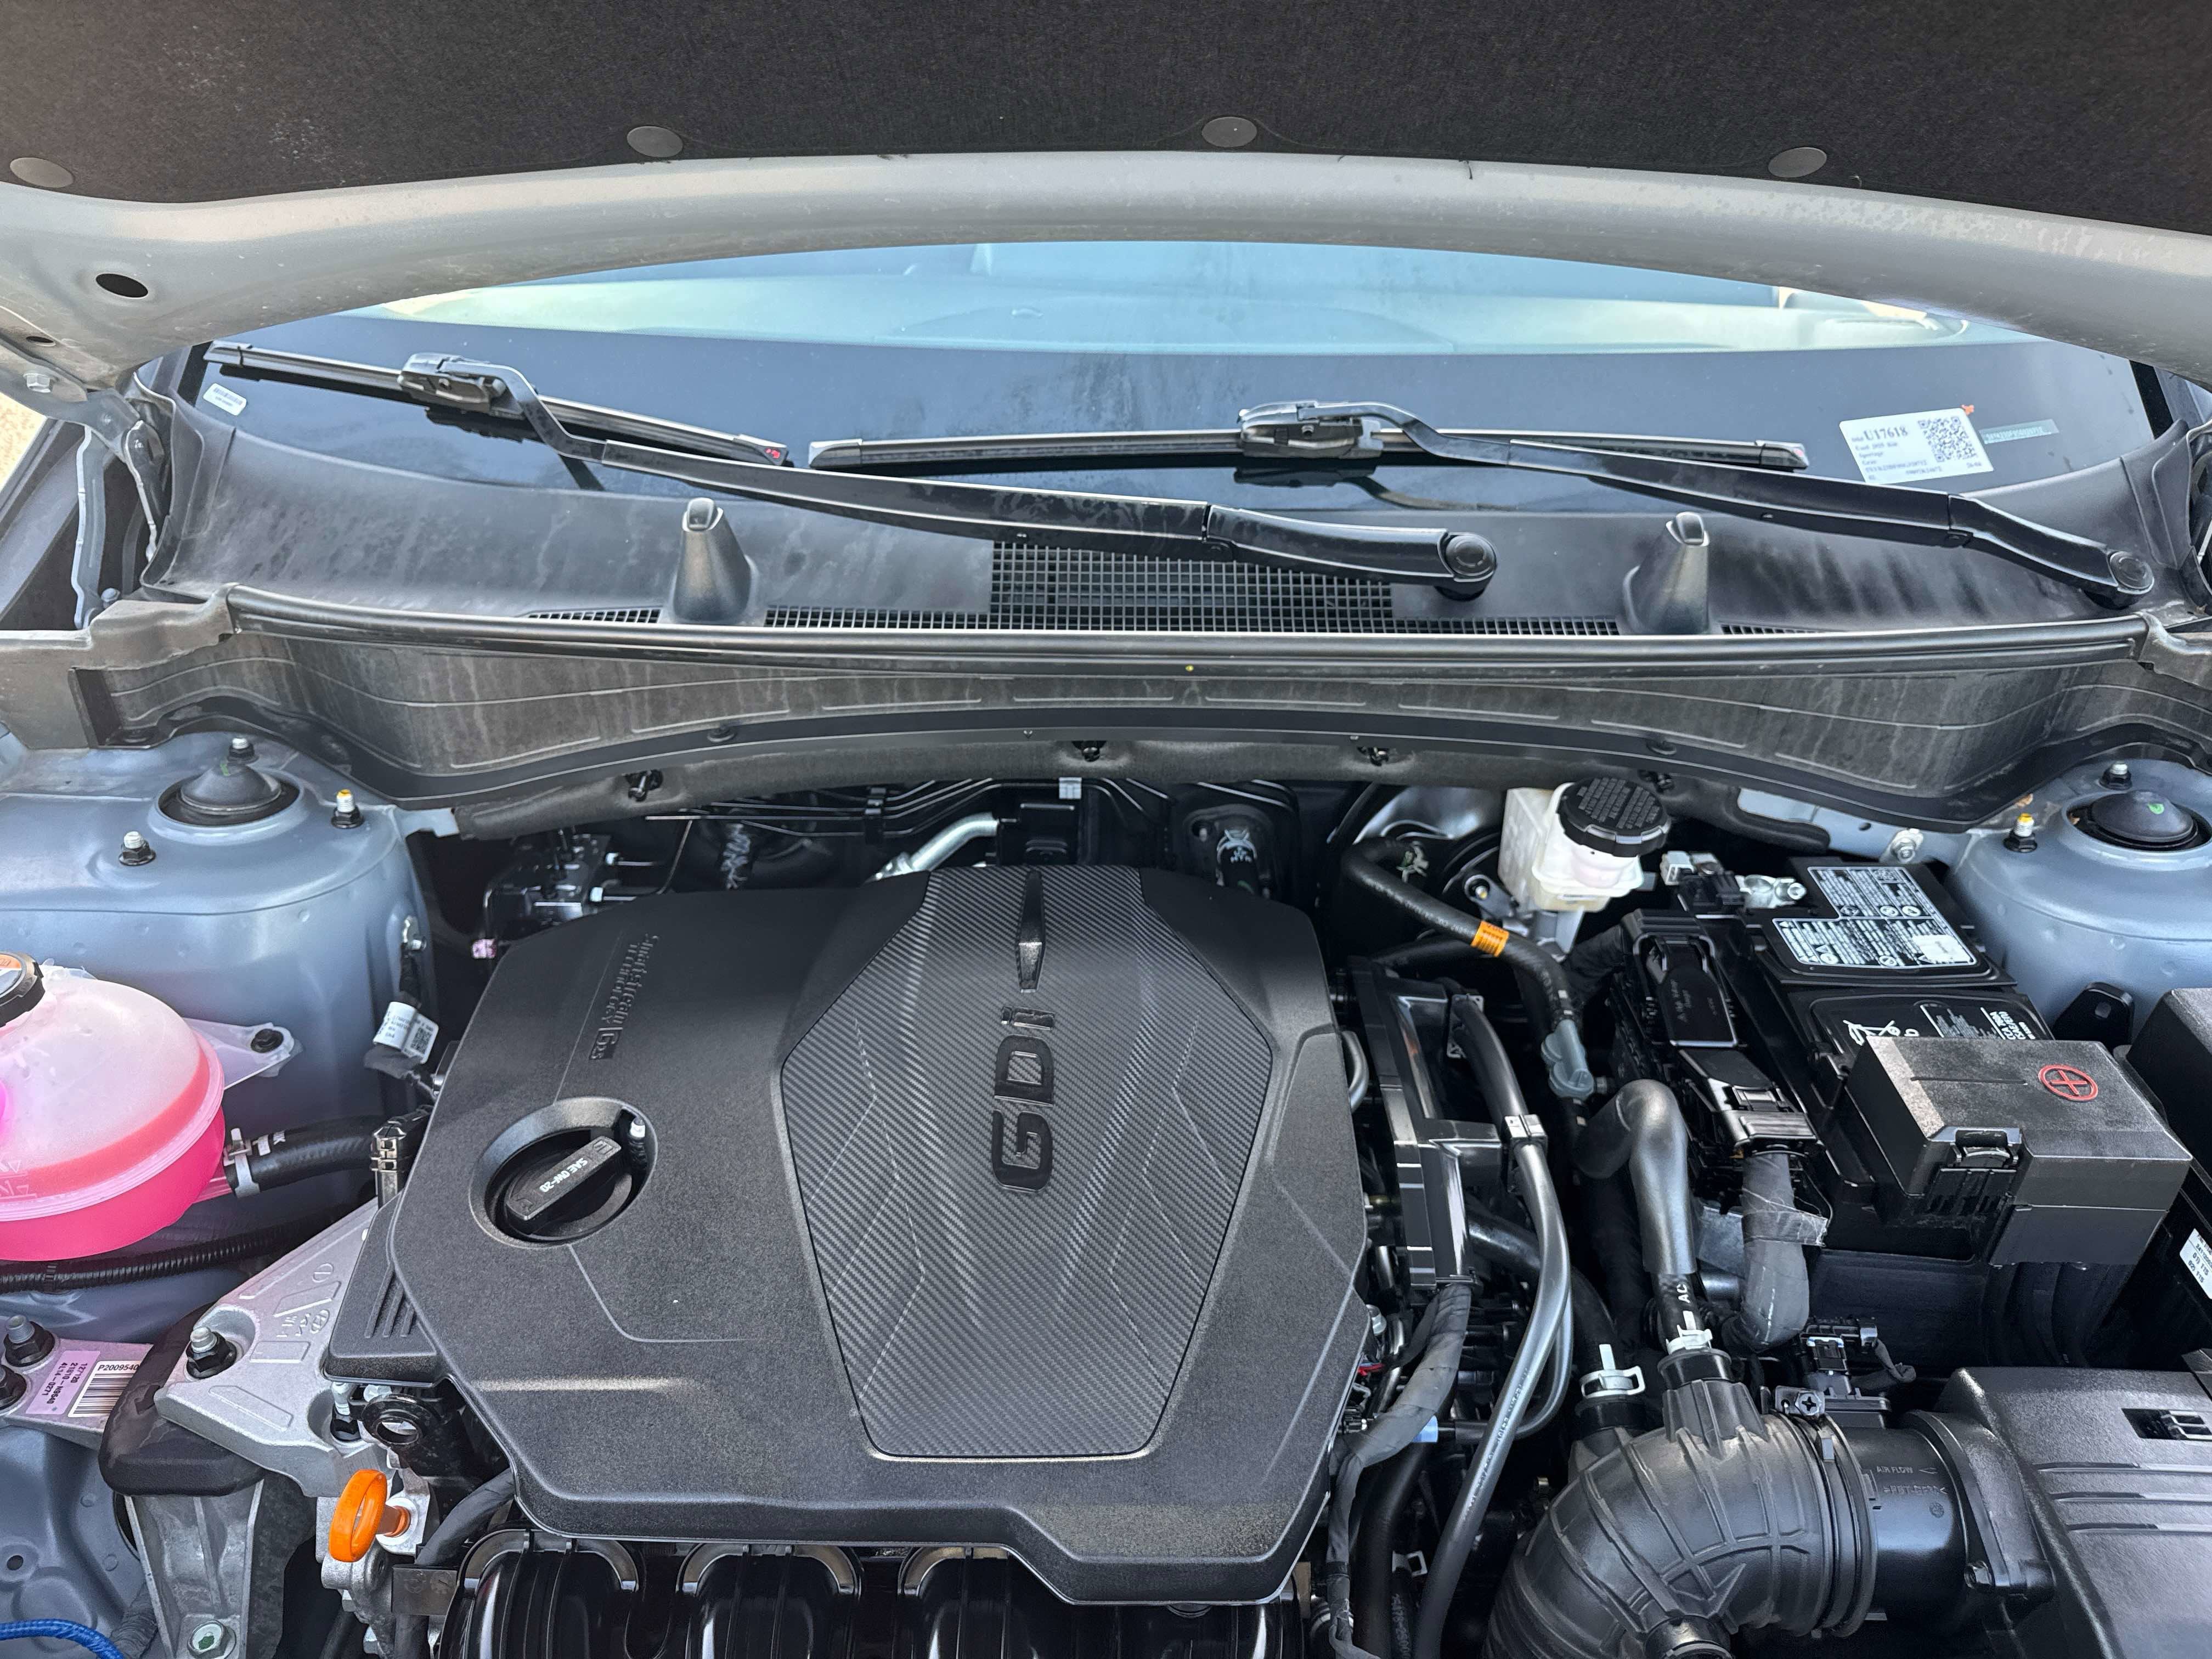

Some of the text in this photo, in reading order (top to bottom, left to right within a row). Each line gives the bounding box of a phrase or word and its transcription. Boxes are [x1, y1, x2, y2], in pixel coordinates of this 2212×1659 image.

[540, 1158, 588, 1193] SAE 0W-20
[1876, 1465, 1914, 1474] AIR FLOW
